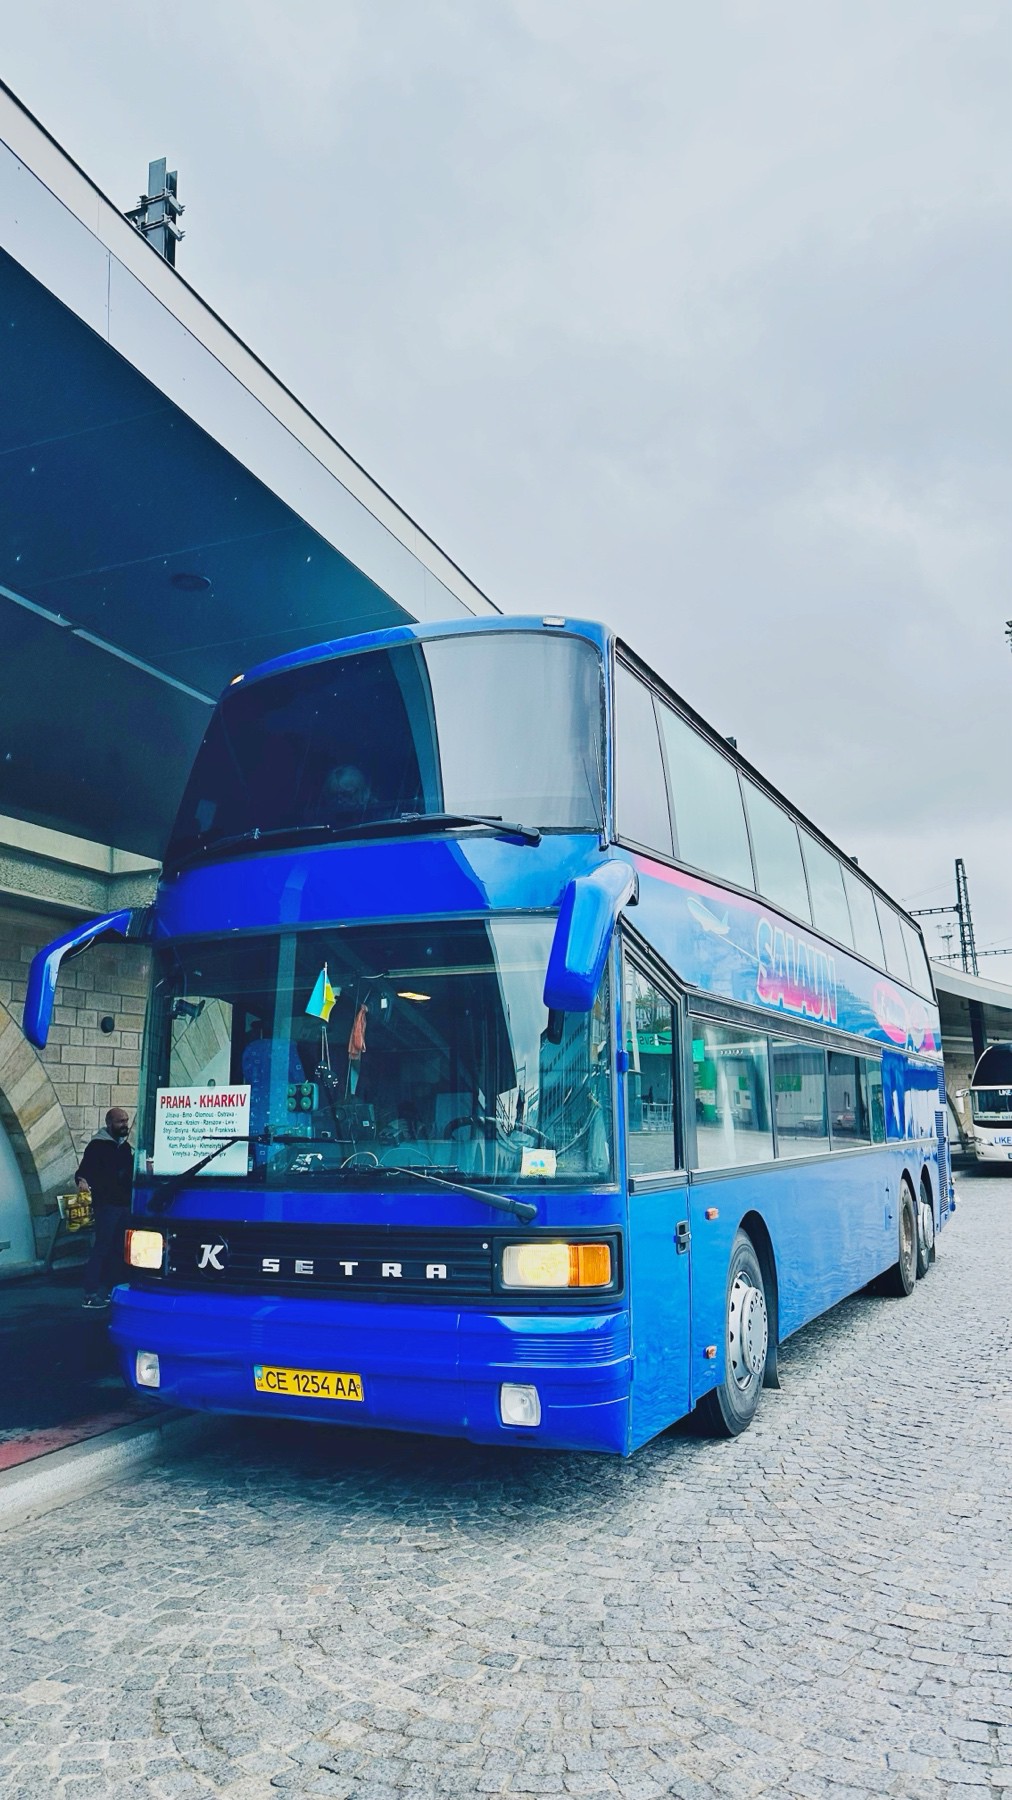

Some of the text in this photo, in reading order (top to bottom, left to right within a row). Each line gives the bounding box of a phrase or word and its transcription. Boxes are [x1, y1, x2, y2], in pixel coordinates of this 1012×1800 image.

[160, 1095, 191, 1109] PRAHA
[199, 1093, 247, 1108] KHARKIV
[262, 1258, 447, 1279] SETRA
[265, 1371, 359, 1397] CE 1254 AA
